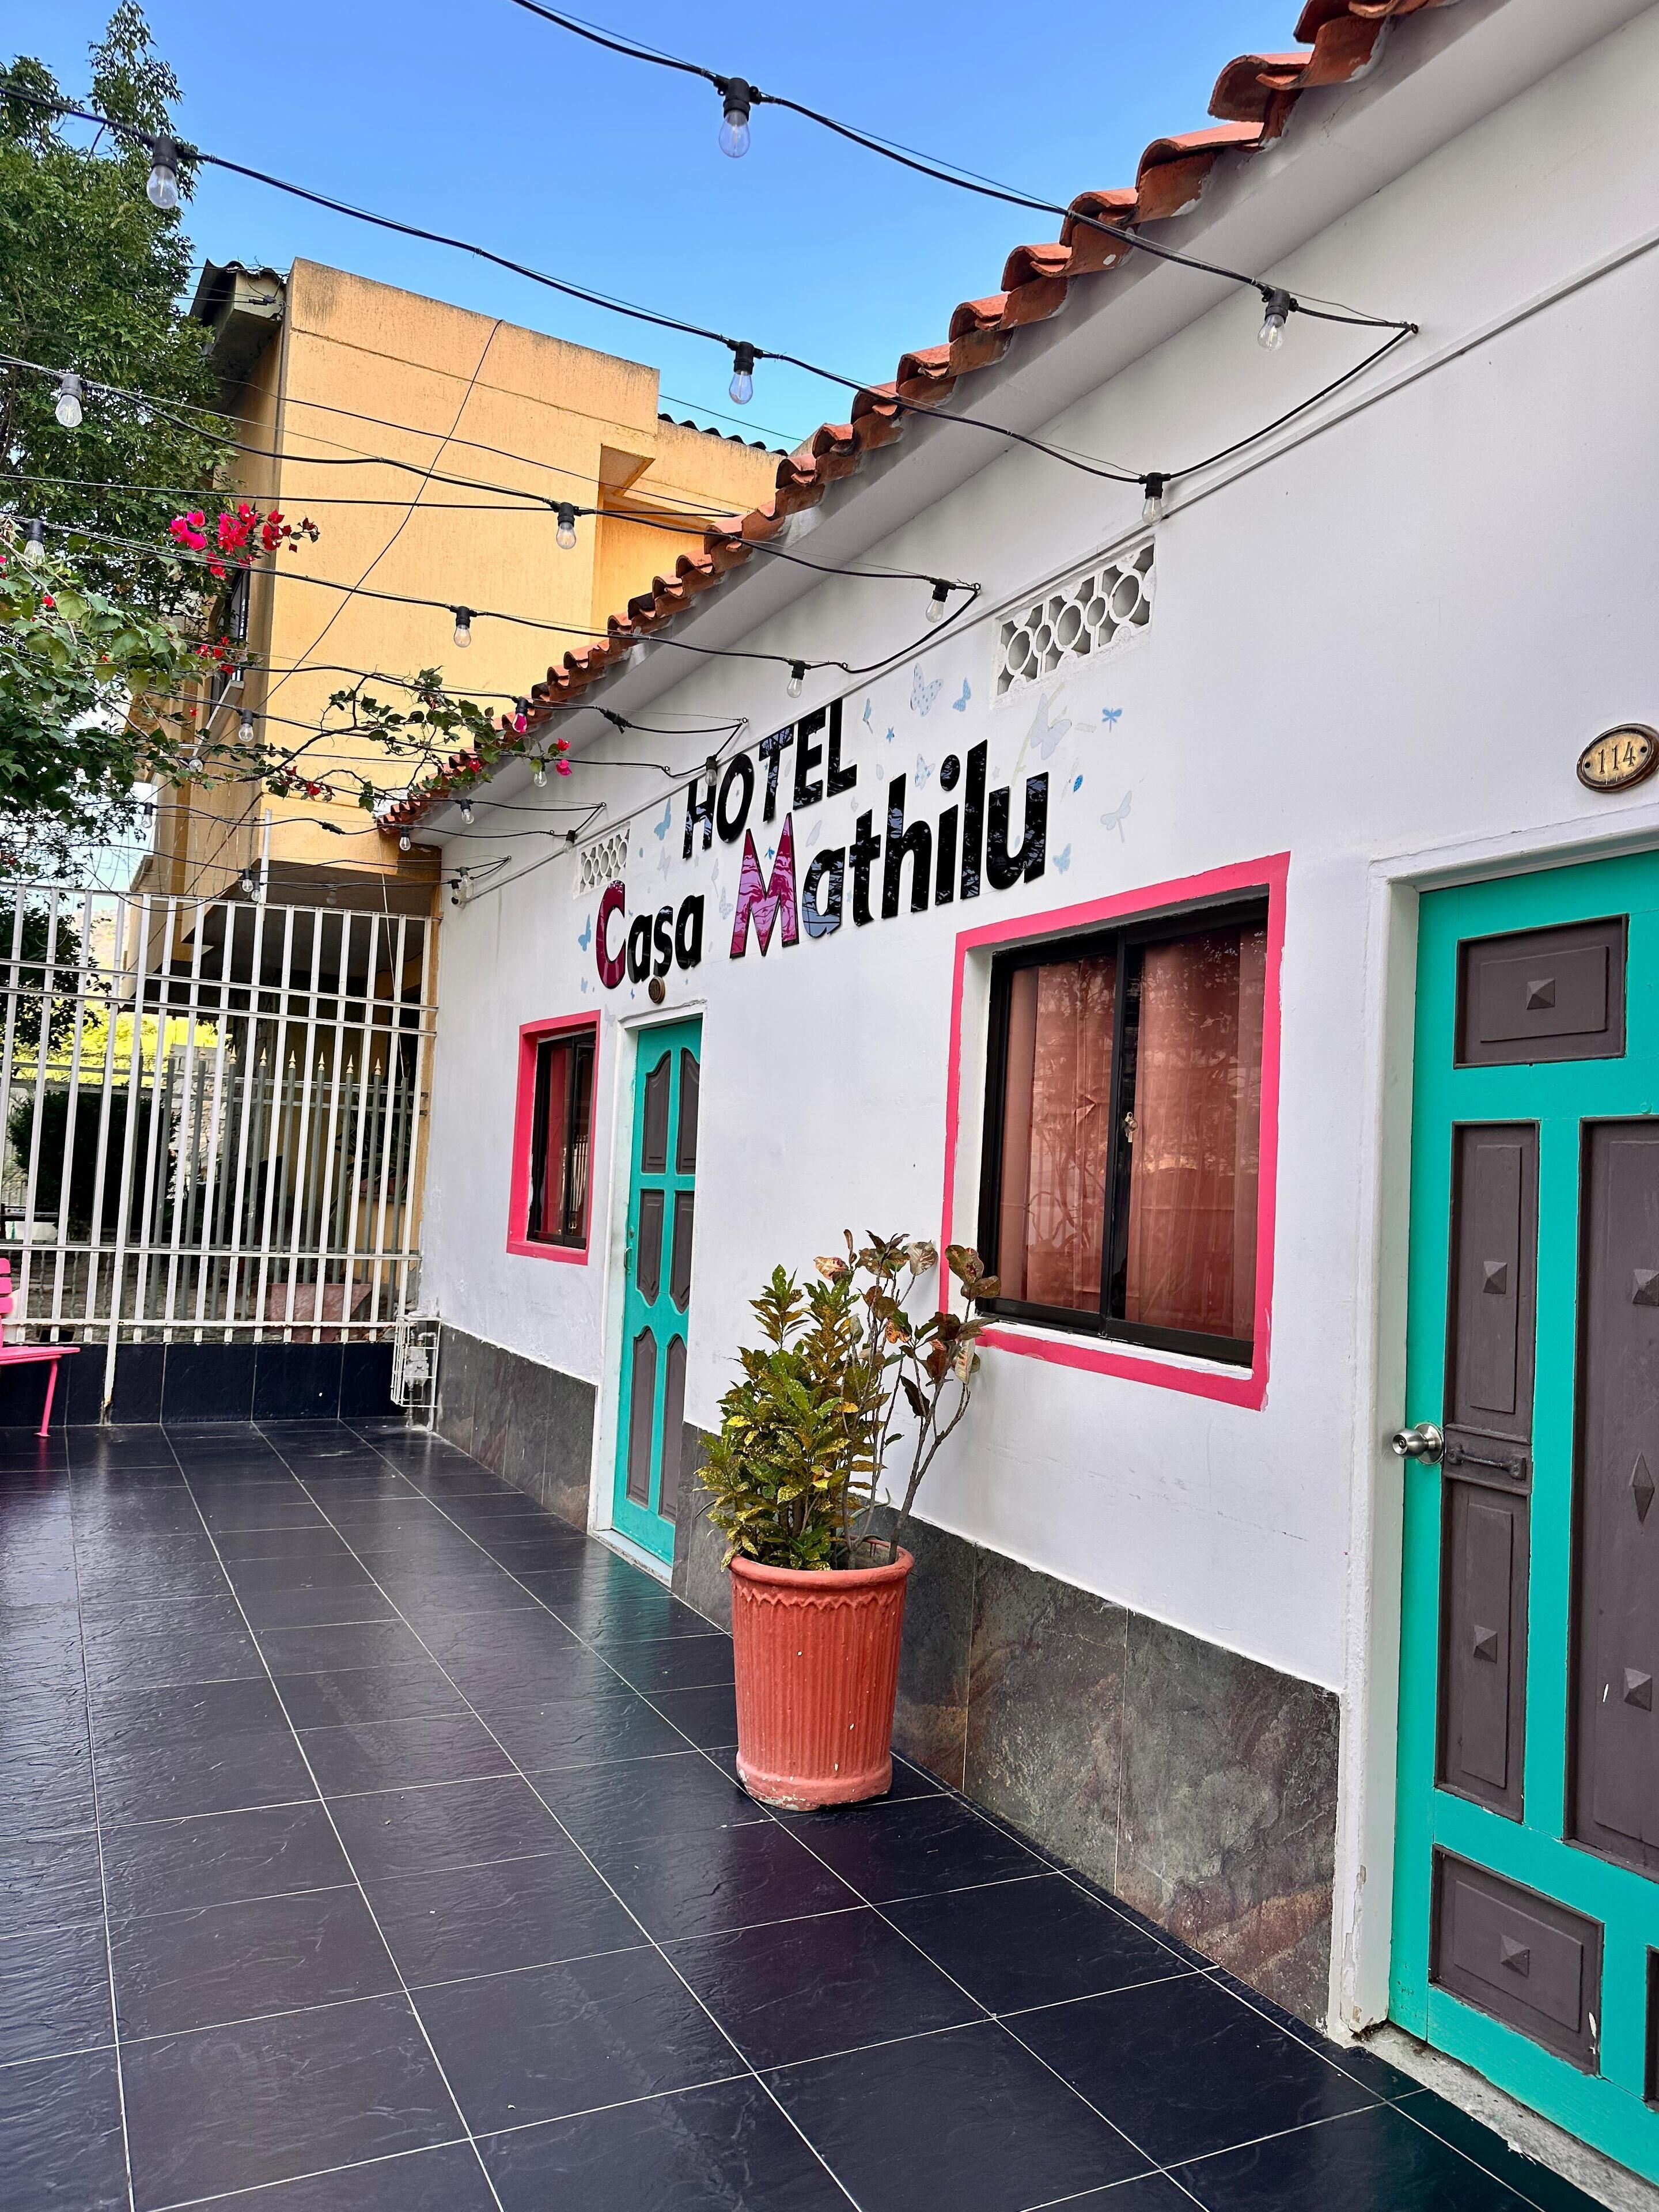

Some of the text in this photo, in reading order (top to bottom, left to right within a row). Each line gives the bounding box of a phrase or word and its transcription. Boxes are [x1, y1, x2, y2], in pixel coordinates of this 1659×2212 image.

[682, 698, 857, 859] HOTEL
[1598, 741, 1637, 775] 114
[596, 740, 1048, 989] Casa Mathilu
